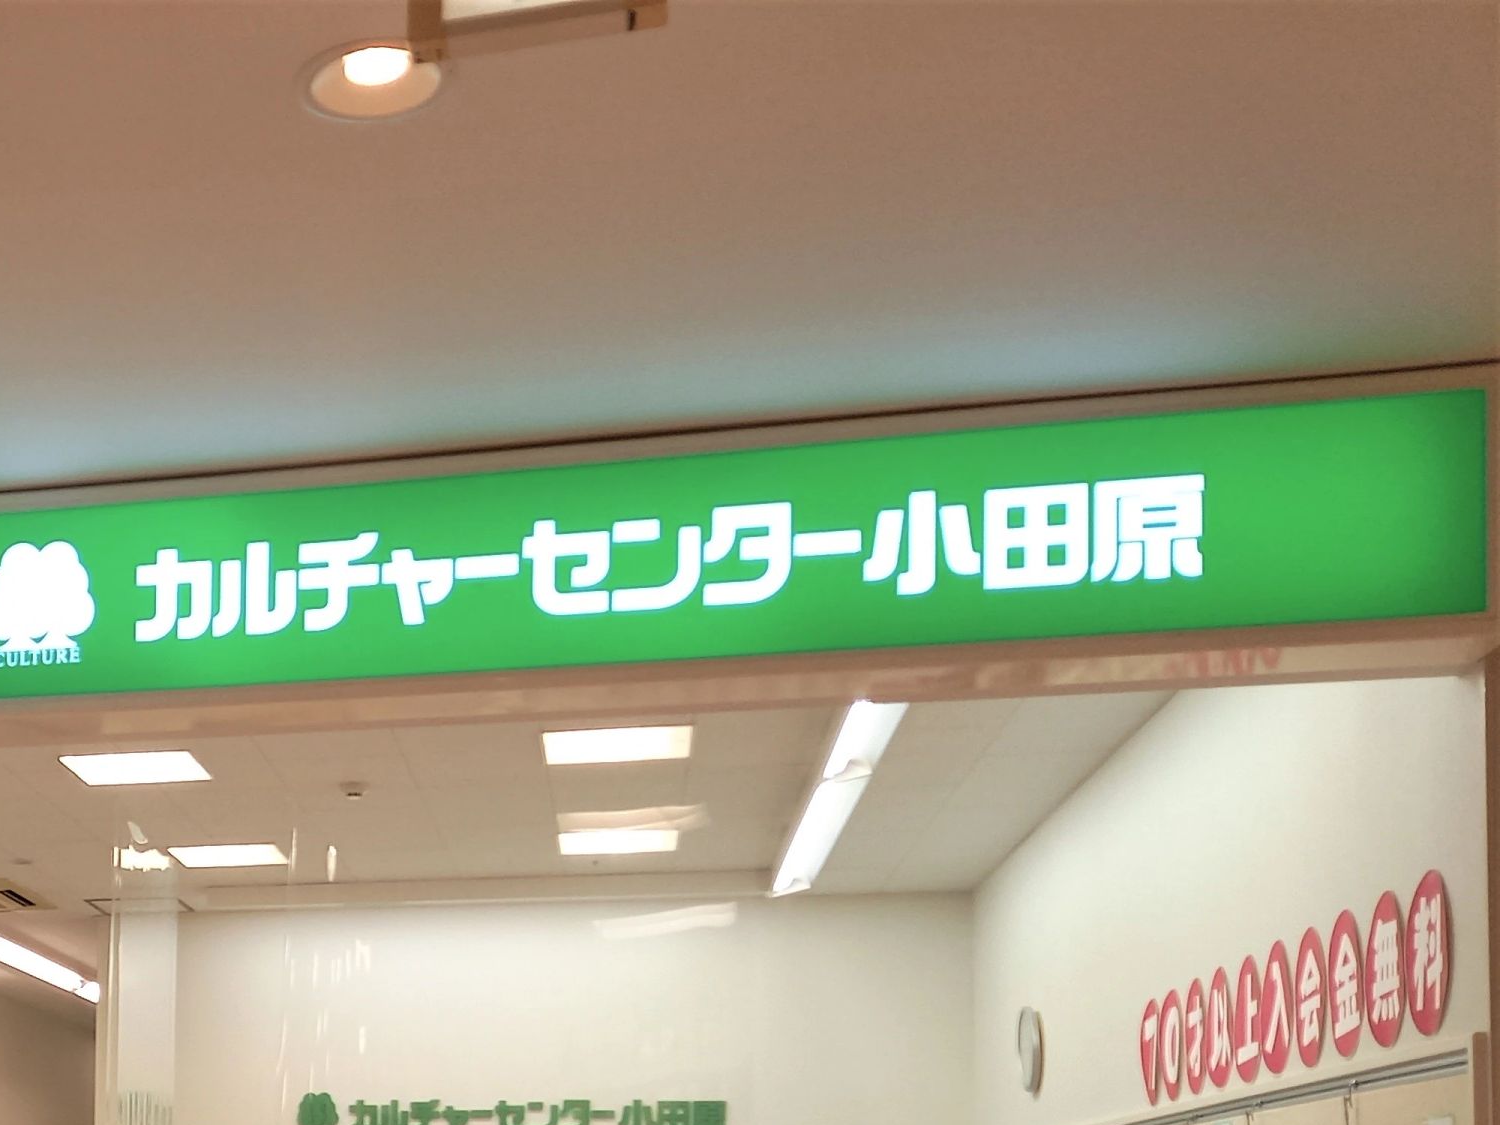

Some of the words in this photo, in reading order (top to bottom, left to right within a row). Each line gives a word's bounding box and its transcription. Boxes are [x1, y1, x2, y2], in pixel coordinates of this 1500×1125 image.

[135, 474, 1205, 643] カルチャーセンター小田原
[1143, 893, 1444, 1090] 70才以上入会金無料
